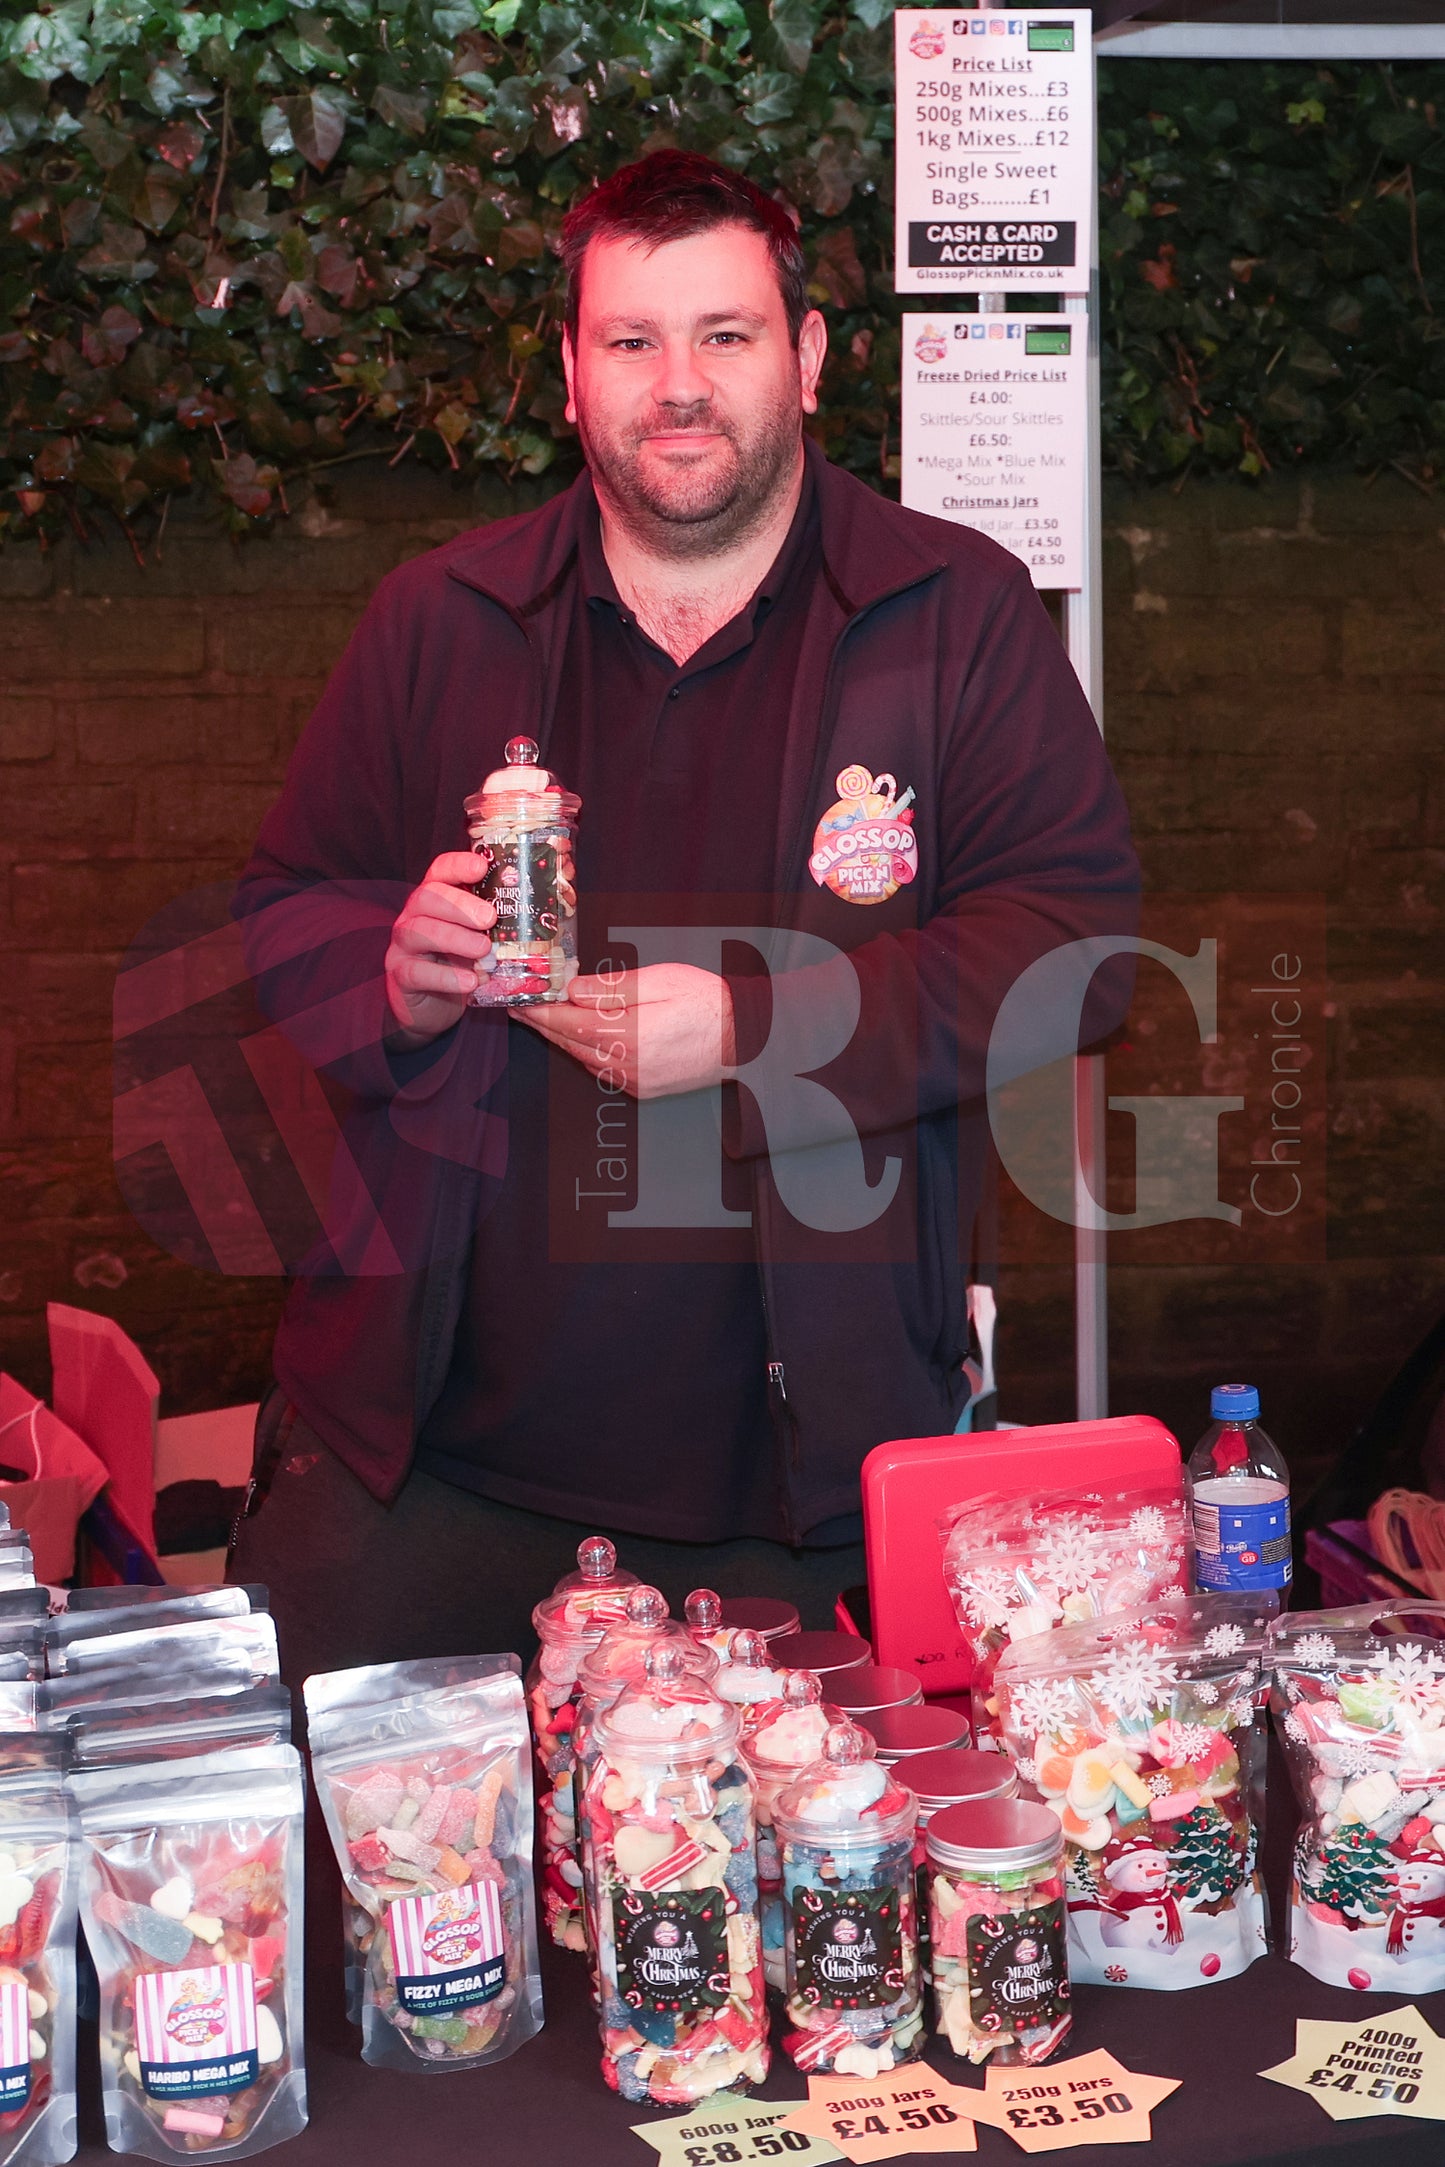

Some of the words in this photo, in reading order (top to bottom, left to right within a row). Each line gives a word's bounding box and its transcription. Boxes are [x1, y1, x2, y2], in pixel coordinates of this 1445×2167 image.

[953, 57, 995, 71] Price
[1002, 57, 1032, 71] List
[916, 82, 962, 102] 250g
[916, 106, 962, 126] 500g
[918, 130, 950, 150] 1kg
[926, 162, 988, 183] Single
[995, 162, 1056, 178] Sweet
[927, 225, 980, 242] CASH
[985, 225, 999, 242] &
[1003, 225, 1058, 242] CARD
[940, 245, 1043, 262] ACCEPTED
[917, 269, 1063, 280] GlossopPicknMix.co.uk
[917, 370, 960, 381] Freeze
[964, 370, 1000, 381] Dried
[1004, 370, 1037, 381] Price
[1042, 370, 1067, 381] List
[970, 392, 1012, 404] £4.00:
[920, 412, 1007, 426] Skittles/Sour
[1013, 412, 1063, 426] Skittles
[970, 434, 1012, 446] £6.50:
[966, 455, 992, 467] Mix
[1040, 455, 1065, 467] Mix
[1000, 474, 1025, 486] Mix
[942, 496, 1009, 507] Christmas
[1013, 496, 1039, 508] Jars
[1028, 537, 1061, 547] £4.50
[1032, 554, 1065, 565] £8.50
[811, 828, 914, 871] GLOSSOP
[838, 867, 872, 883] PICK
[875, 866, 889, 880] N
[850, 880, 882, 894] MIX
[626, 1914, 653, 1944] WISHING
[805, 1912, 832, 1940] WISHING
[422, 1924, 480, 1951] GLOSSOP
[437, 1946, 457, 1956] PICK
[444, 1952, 462, 1961] MIX
[644, 1946, 684, 1963] MERRY
[824, 1943, 862, 1960] MERRY
[984, 1934, 1014, 1968] WISHING
[633, 1958, 700, 1987] CHRISTMAS
[812, 1954, 878, 1983] CHRISTMAS
[1005, 1963, 1042, 1979] MERRY
[404, 1984, 442, 2000] FIZZY
[445, 1975, 482, 1995] MEGA
[484, 1966, 502, 1985] MIX
[427, 2000, 437, 2008] OF
[165, 2008, 224, 2031] GLOSSOP
[1359, 2028, 1418, 2050] 400g
[1340, 2041, 1423, 2065] Printed
[148, 2071, 191, 2084] HARIBO
[193, 2066, 228, 2082] MEGA
[229, 2060, 249, 2076] MIX
[1326, 2054, 1423, 2080] Pouches
[6, 2075, 26, 2090] MIX
[1002, 2086, 1062, 2102] 250g
[1067, 2077, 1113, 2094] Jars
[1305, 2069, 1419, 2104] £4.50
[826, 2098, 885, 2113] 300g
[891, 2089, 936, 2104] Jars
[1006, 2093, 1133, 2128] £3.50
[832, 2104, 958, 2140] £4.50
[679, 2123, 739, 2140] 600g
[684, 2130, 811, 2166] £8.50
